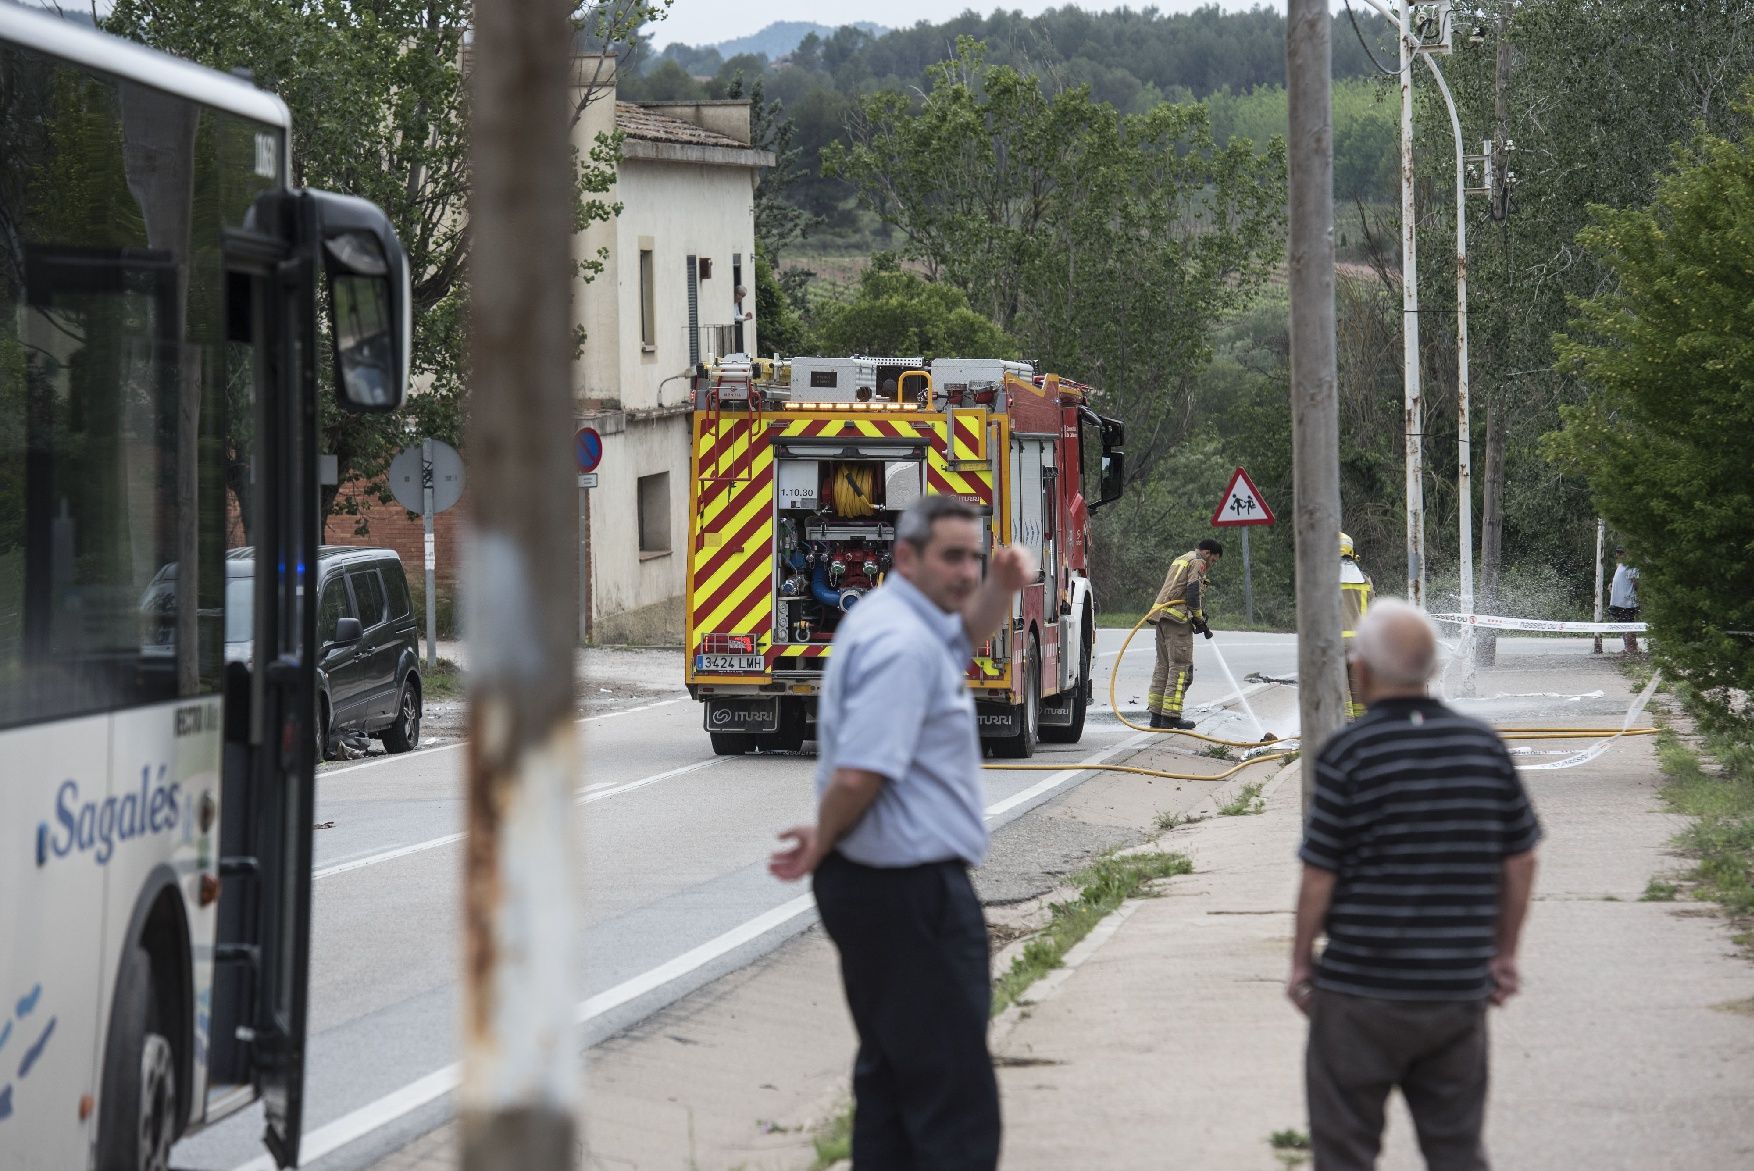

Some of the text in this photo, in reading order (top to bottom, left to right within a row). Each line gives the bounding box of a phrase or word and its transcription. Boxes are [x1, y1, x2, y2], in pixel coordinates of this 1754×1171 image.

[781, 488, 814, 497] 1.10.30
[705, 656, 761, 669] 3424 LMH
[734, 711, 773, 722] ITURRI
[976, 715, 1012, 725] TURRI
[52, 763, 182, 865] Sagalés
